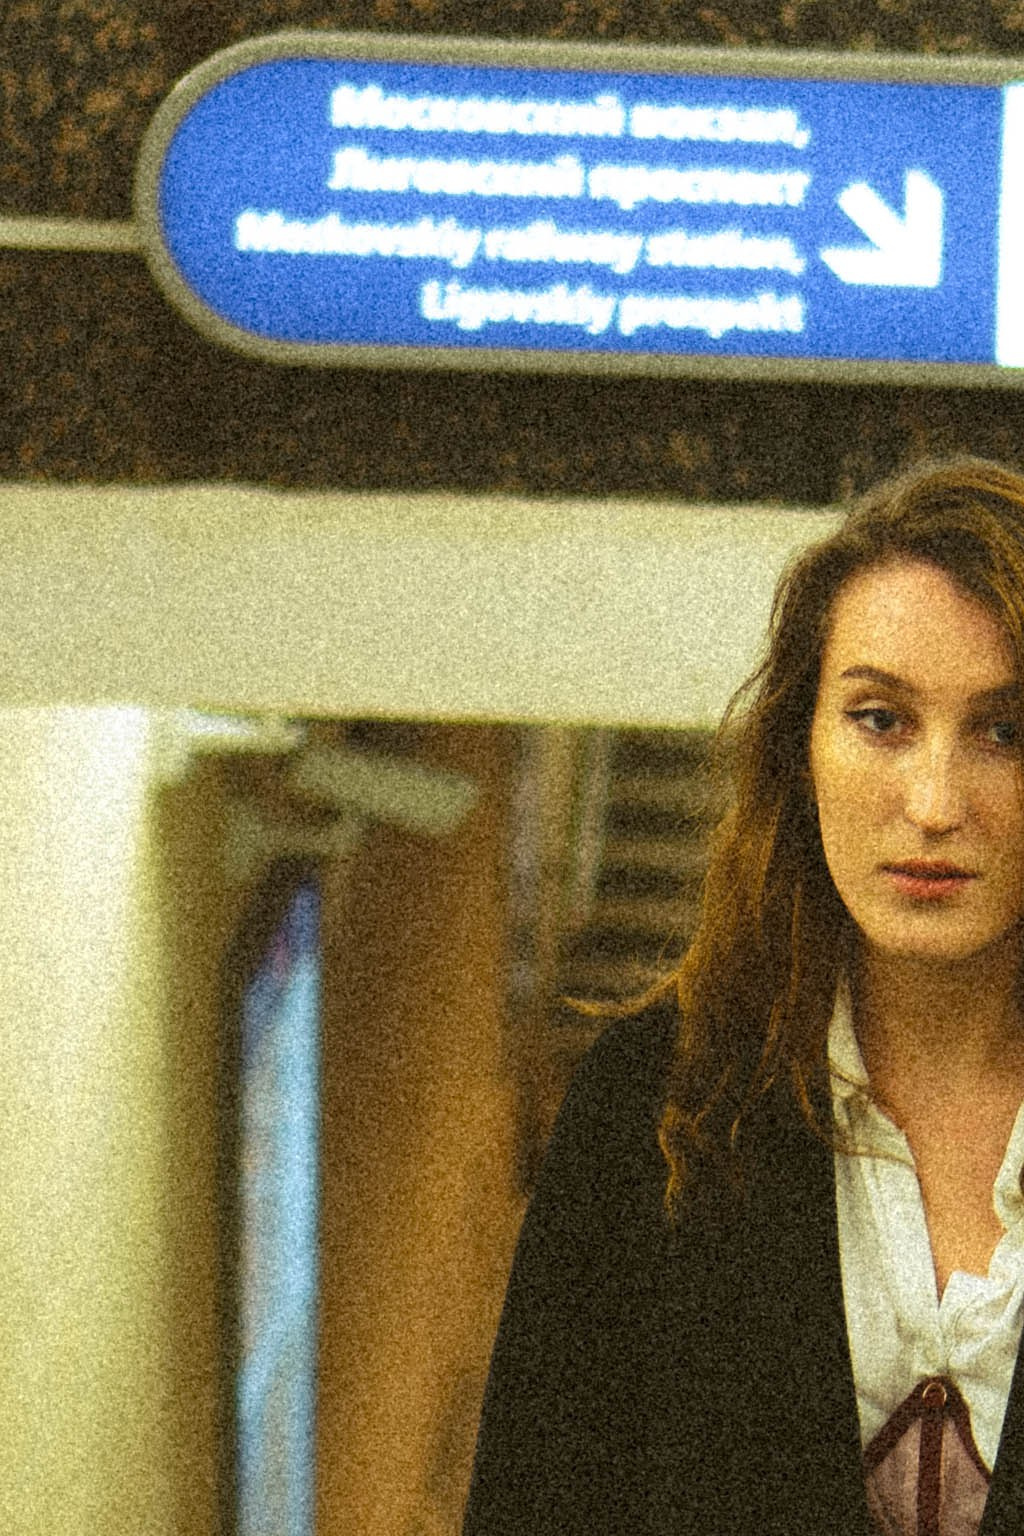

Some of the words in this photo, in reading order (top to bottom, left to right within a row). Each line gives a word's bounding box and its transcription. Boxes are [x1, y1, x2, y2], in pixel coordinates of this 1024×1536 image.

[332, 86, 625, 137] Московский
[329, 147, 585, 197] Лиговский
[588, 165, 811, 209] проспект
